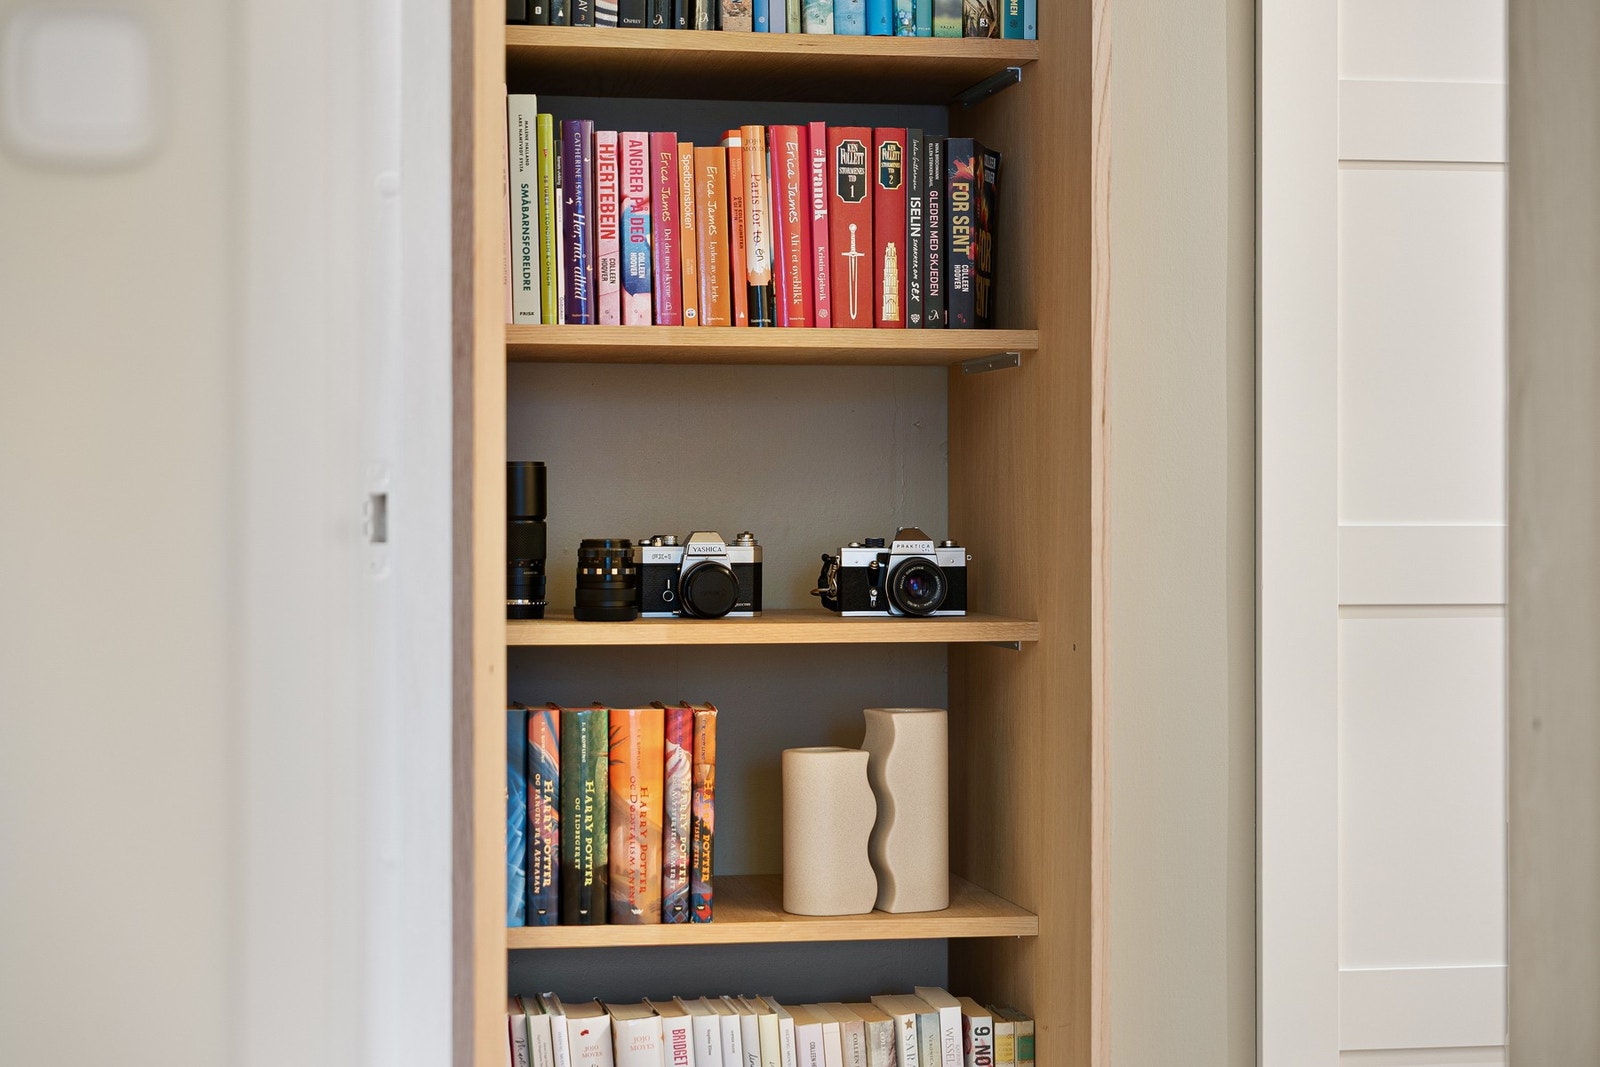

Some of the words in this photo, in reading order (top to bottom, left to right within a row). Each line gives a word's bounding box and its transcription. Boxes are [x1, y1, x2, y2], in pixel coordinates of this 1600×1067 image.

[786, 141, 799, 178] Erica
[840, 148, 865, 165] FOLLETT
[847, 144, 859, 152] KEN
[882, 147, 901, 160] FOLLETT
[629, 139, 644, 192] ANGRER
[660, 152, 671, 184] Erica
[707, 166, 718, 197] Erica
[888, 175, 894, 184] 2
[599, 144, 616, 239] HJERTEBEIN
[750, 173, 762, 205] Paris
[813, 148, 827, 221] #branok
[850, 185, 855, 198] 1
[952, 182, 970, 211] FOR
[630, 197, 648, 213] PÅ
[661, 187, 671, 222] James
[708, 200, 717, 235] James
[752, 209, 764, 227] for
[787, 182, 799, 224] James
[910, 197, 921, 237] ISELIN
[929, 190, 938, 228] GLEDEN
[521, 183, 531, 291] SMÅBARNSFORELDRE
[573, 213, 586, 238] Her,
[630, 217, 644, 243] DEG
[664, 229, 672, 240] Del
[791, 232, 800, 246] Alt
[930, 230, 938, 251] MED
[952, 215, 970, 255] SENT
[573, 242, 587, 262] nå,
[664, 242, 672, 254] det
[708, 241, 717, 263] Lyden
[792, 254, 799, 263] et
[574, 266, 587, 301] alltid
[663, 273, 672, 297] skyene
[710, 265, 716, 273] av
[711, 275, 717, 283] en
[790, 265, 802, 304] øyeblikk
[930, 253, 938, 296] SKJEDEN
[711, 285, 719, 303] lerke
[817, 272, 826, 301] Gjelsvik
[911, 281, 920, 302] SEX
[543, 780, 554, 832] HARRY
[584, 780, 595, 832] HARRY
[640, 787, 649, 838] HARRY
[680, 781, 689, 831] HARRY
[702, 778, 714, 830] HARRY
[629, 794, 637, 905] DØDSTALISMANENE
[670, 790, 678, 889] MYSTERIEKAMMERET
[543, 838, 552, 887] POTTER
[584, 837, 593, 886] POTTER
[639, 844, 648, 894] POTTER
[678, 837, 687, 884] POTTER
[701, 834, 711, 882] POTTER
[630, 1043, 655, 1051] MOYES
[633, 1035, 650, 1043] JOJO
[671, 1028, 688, 1066] BRIDGET
[809, 1041, 817, 1062] COLLEEN
